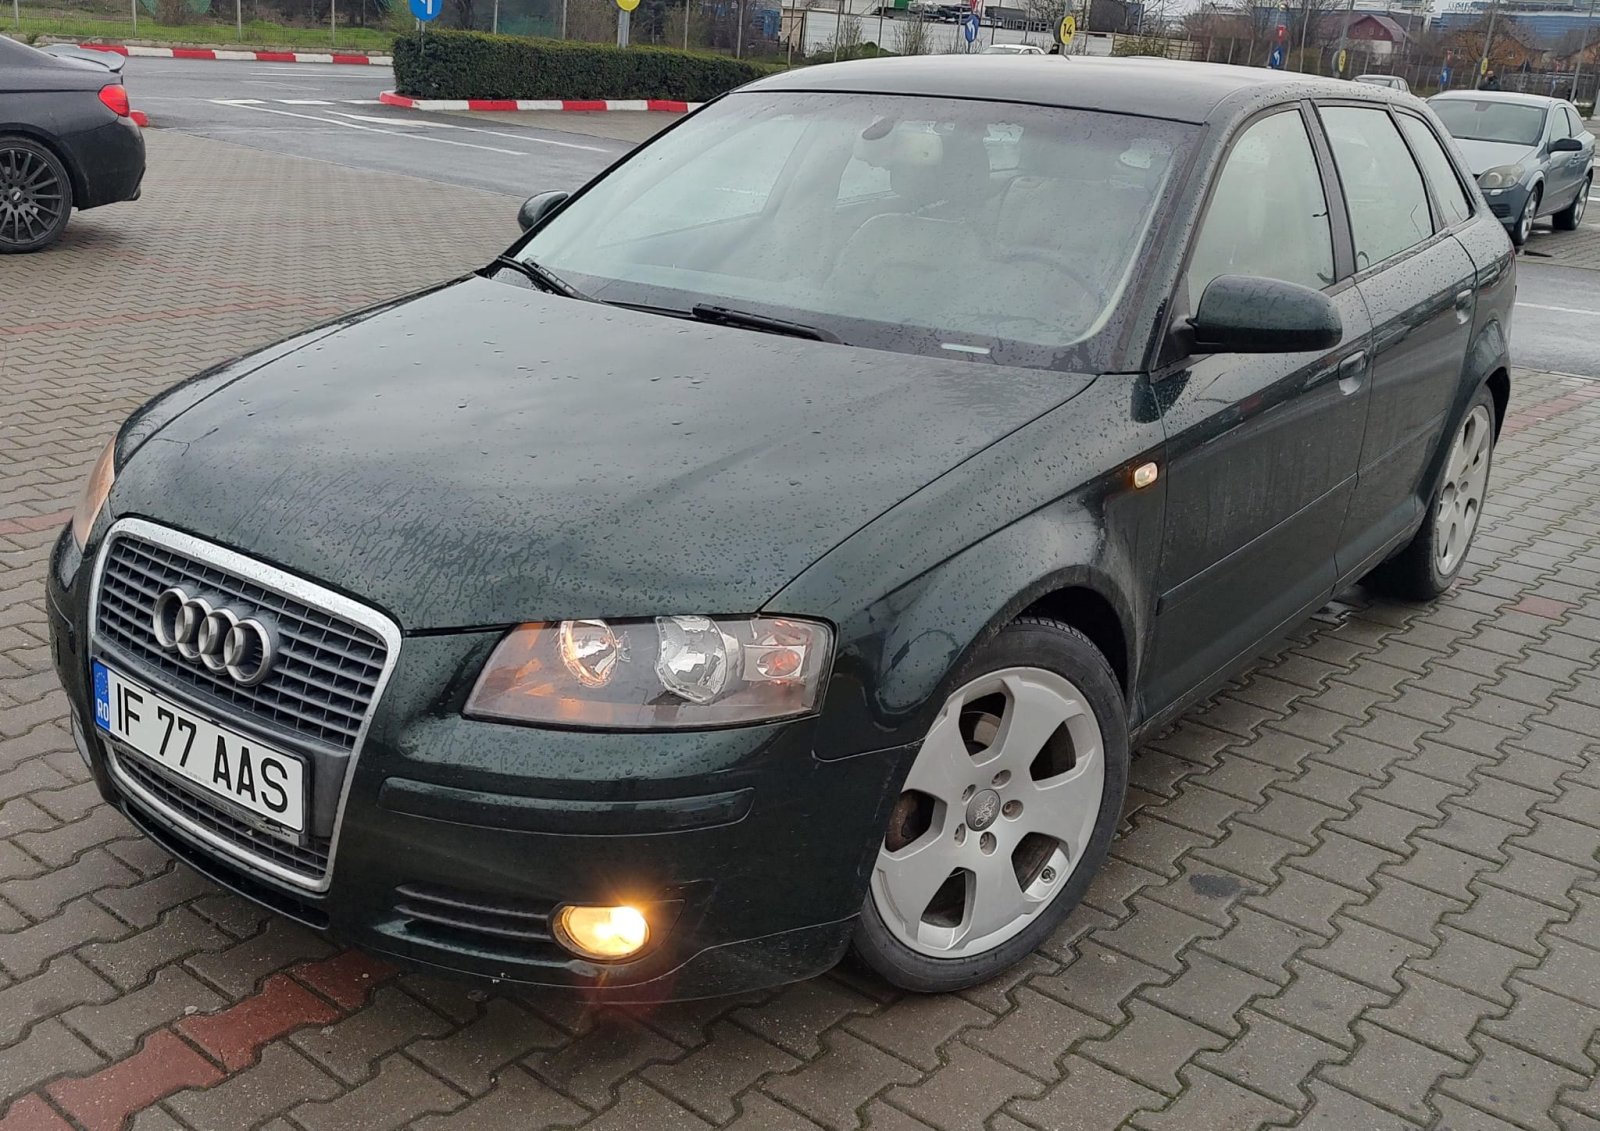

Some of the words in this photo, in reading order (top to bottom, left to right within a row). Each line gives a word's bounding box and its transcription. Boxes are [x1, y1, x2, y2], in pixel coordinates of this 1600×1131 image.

[1063, 23, 1072, 37] 14
[97, 698, 109, 722] RO
[117, 682, 143, 736] IF
[157, 706, 197, 767] 77
[213, 734, 288, 813] AAS
